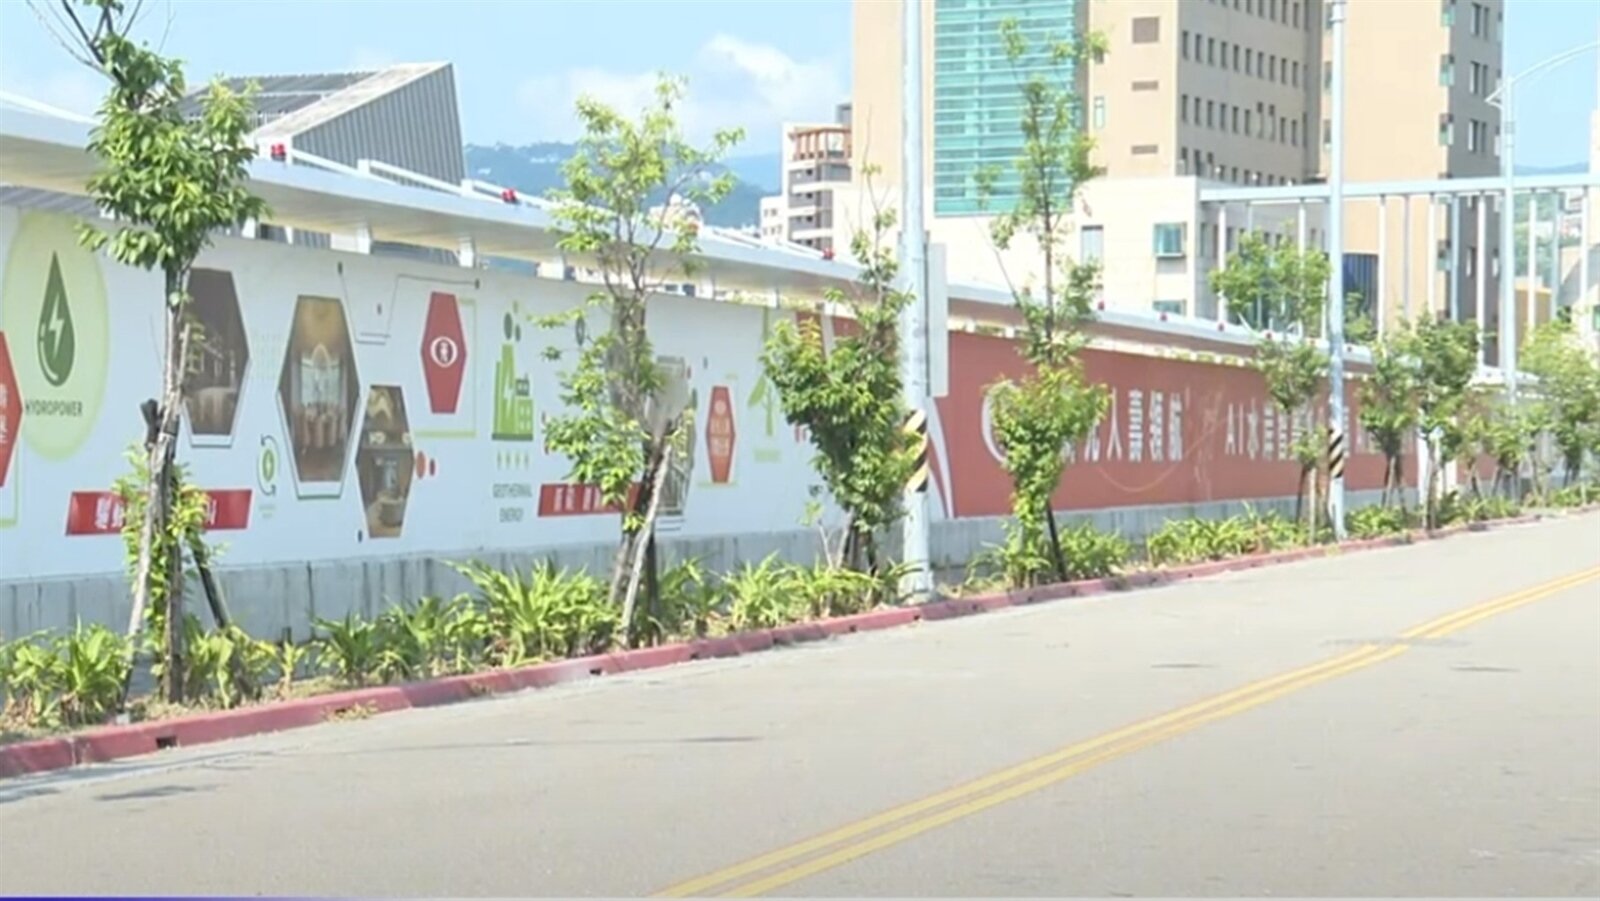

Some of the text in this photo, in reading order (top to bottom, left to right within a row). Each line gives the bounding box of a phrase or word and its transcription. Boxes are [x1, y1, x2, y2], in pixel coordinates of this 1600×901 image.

[25, 399, 83, 417] HYDROPOWER
[1059, 386, 1184, 464] 光人壽領航
